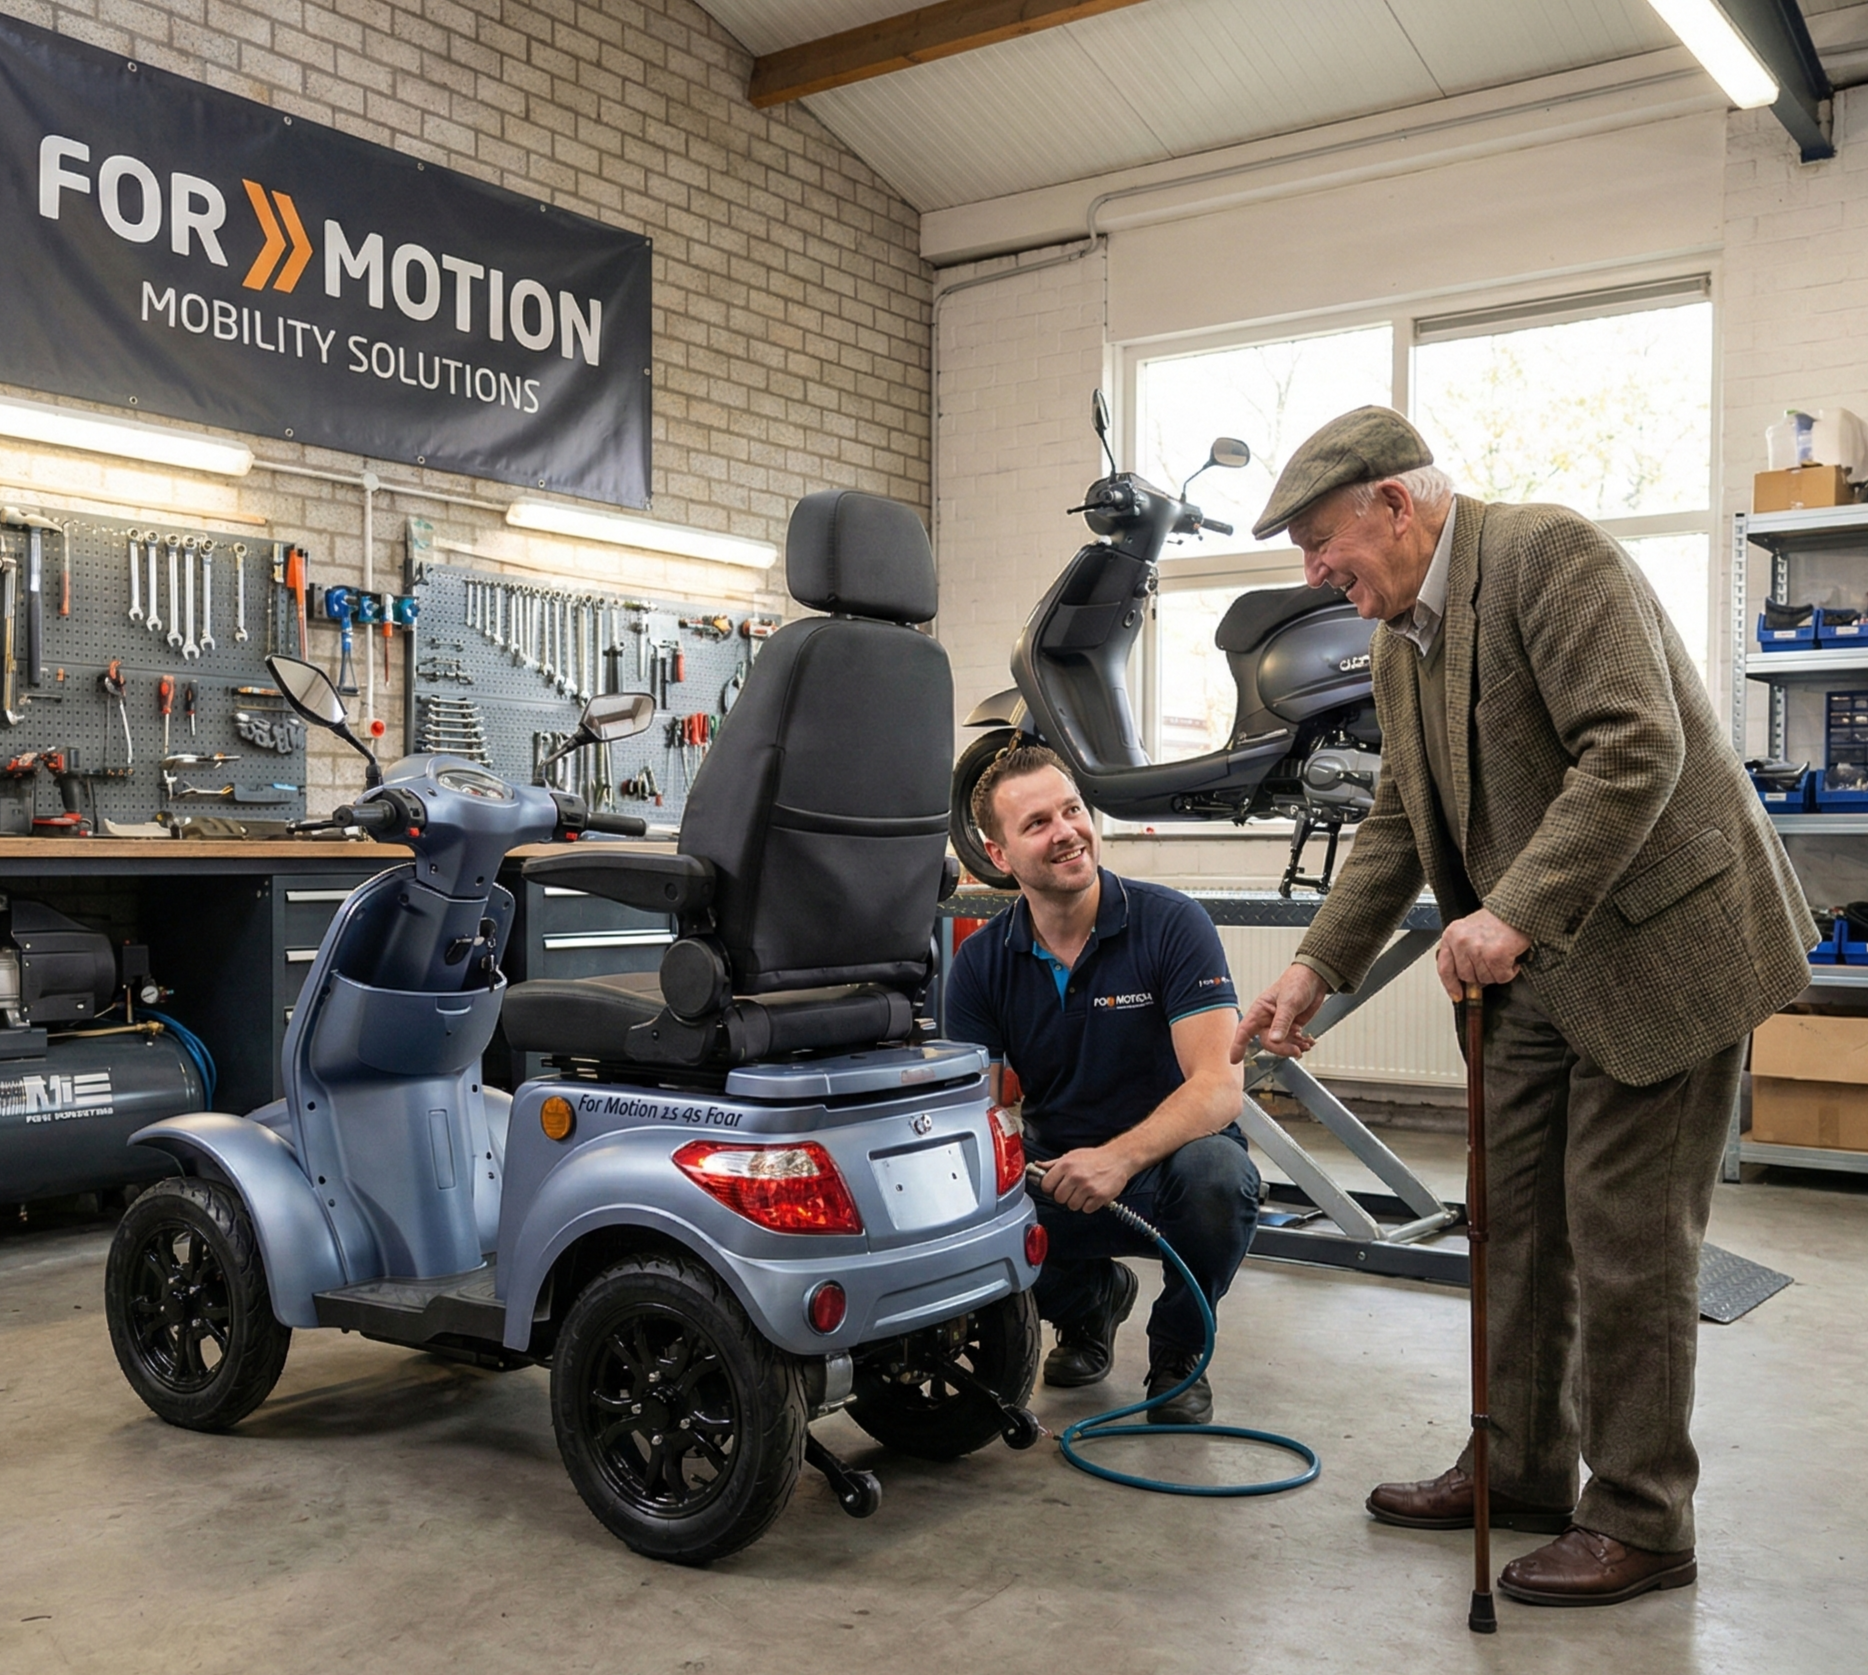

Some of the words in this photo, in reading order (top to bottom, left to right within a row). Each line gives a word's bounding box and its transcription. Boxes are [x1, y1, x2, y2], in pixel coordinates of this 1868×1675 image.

[39, 134, 229, 267] FOR
[323, 219, 603, 366] MOTION
[141, 281, 336, 364] MOBILITY
[347, 336, 541, 414] SOLUTIONS
[578, 1094, 603, 1113] For
[603, 1096, 658, 1119] Motion
